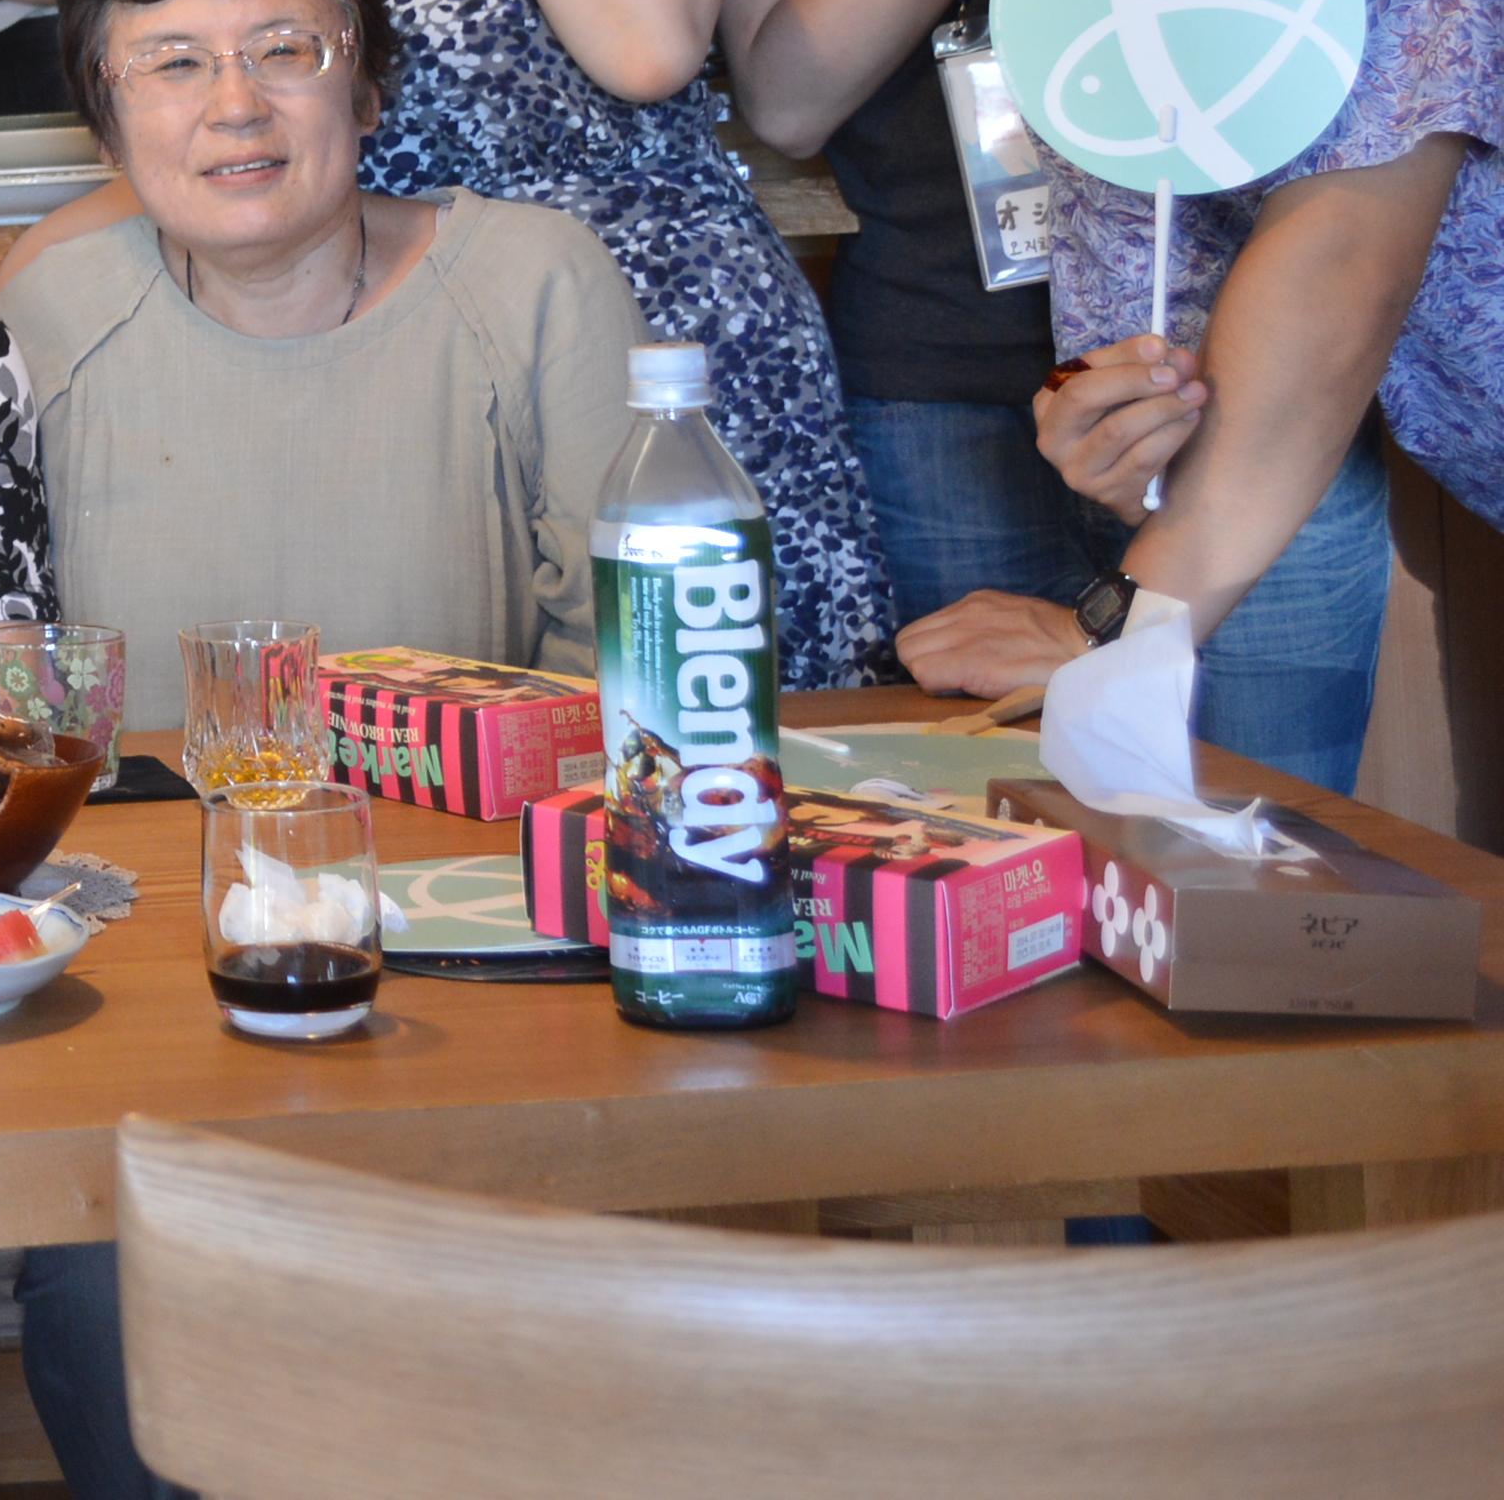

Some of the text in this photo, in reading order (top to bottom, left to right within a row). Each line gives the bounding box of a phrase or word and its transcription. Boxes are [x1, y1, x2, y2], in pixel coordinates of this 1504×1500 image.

[327, 710, 420, 744] REAL BROWNIE
[669, 559, 777, 884] Blendy
[1300, 913, 1359, 936] ネピア
[634, 989, 684, 1005] コーヒー
